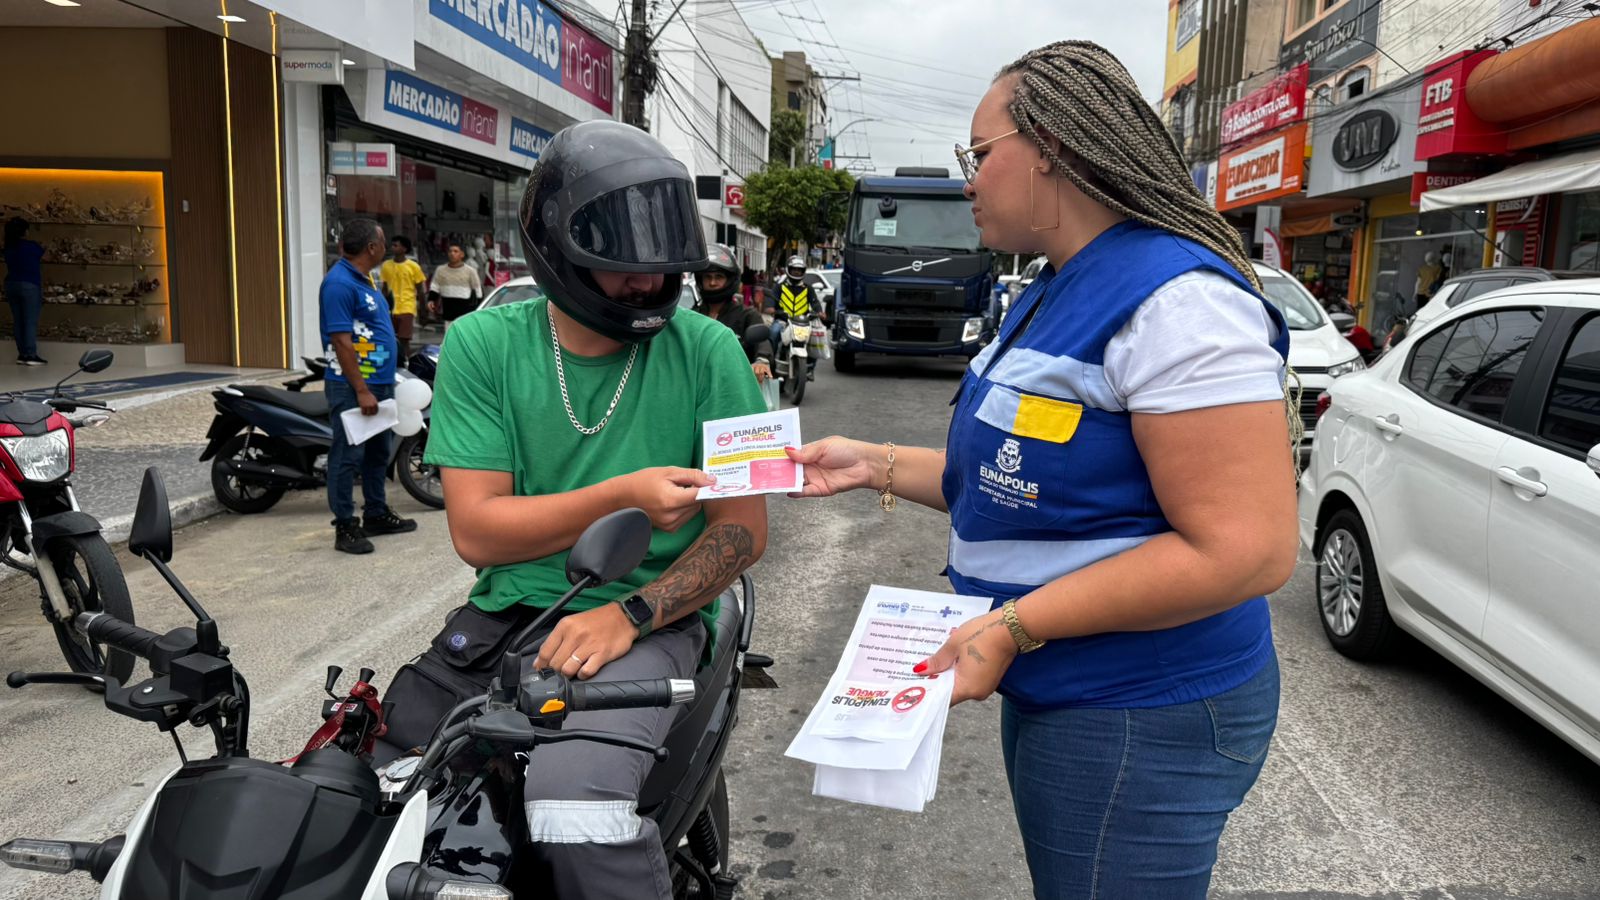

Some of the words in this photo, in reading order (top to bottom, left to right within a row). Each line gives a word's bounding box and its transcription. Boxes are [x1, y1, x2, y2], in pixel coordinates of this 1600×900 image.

[441, 0, 560, 70] RCADÃO
[565, 28, 611, 103] infantil
[284, 60, 332, 69] supermoda
[1425, 78, 1454, 107] FTB
[388, 80, 460, 126] MERCADÃO
[463, 104, 496, 142] infantil
[512, 127, 549, 153] MERCAD
[733, 424, 783, 438] EUNÁPOLIS
[741, 433, 776, 443] DENGUE
[980, 465, 1039, 494] EUNÁPOLIS
[978, 484, 1006, 500] SECRETARIA
[1006, 495, 1038, 509] MUNICIPAL
[999, 498, 1019, 509] SAÚDE
[831, 695, 891, 709] EUNÁPOLIS
[846, 687, 889, 698] DENGUE
